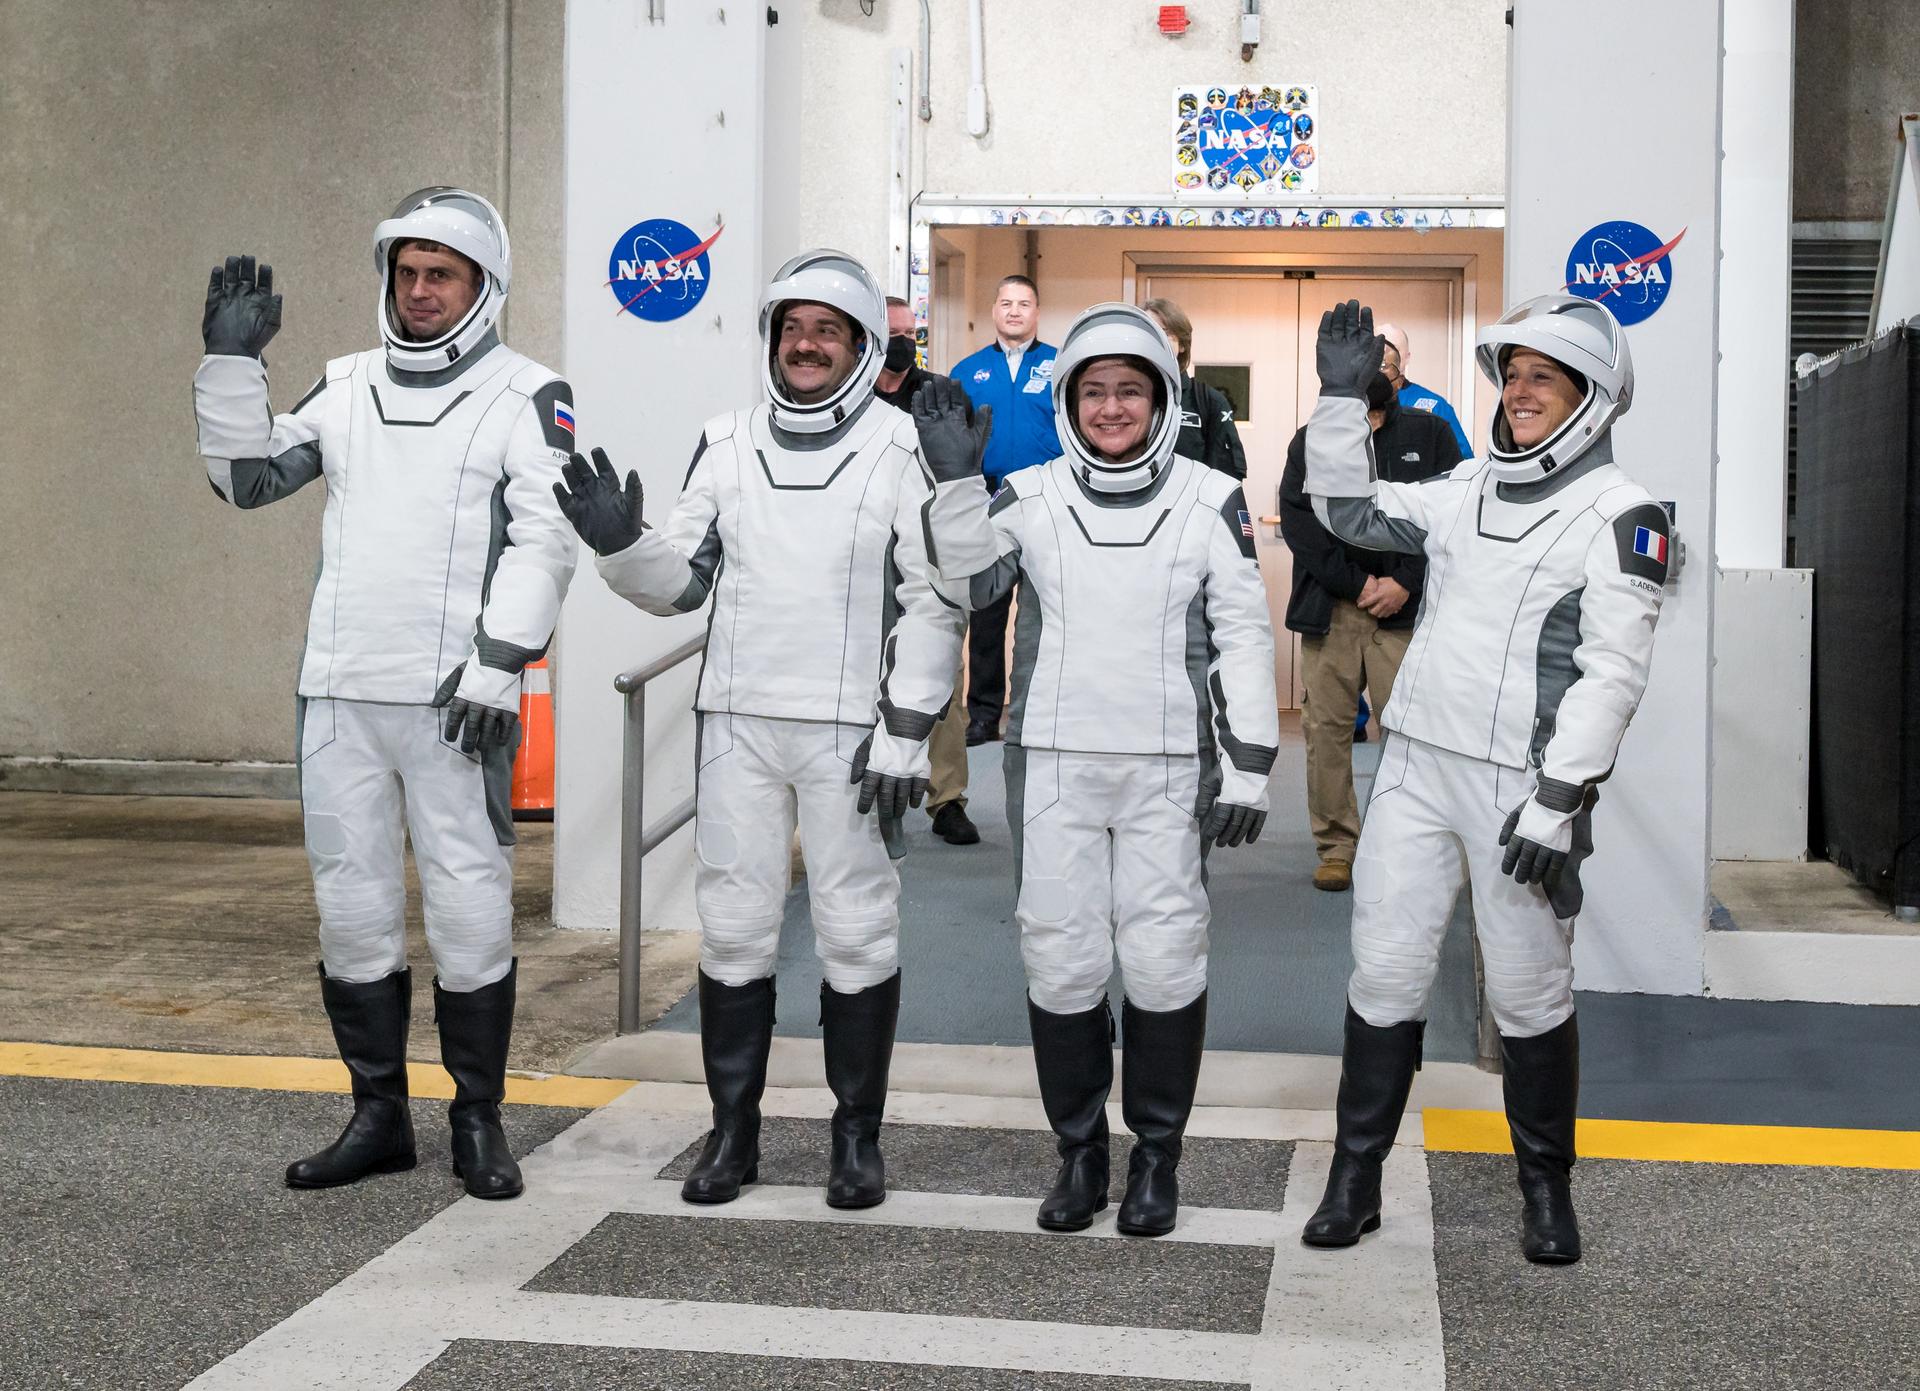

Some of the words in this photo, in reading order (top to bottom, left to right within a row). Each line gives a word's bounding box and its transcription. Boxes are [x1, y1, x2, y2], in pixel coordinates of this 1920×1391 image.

[1206, 129, 1288, 150] NASA
[617, 259, 705, 281] NASA
[1574, 262, 1666, 284] NASA
[1629, 578, 1663, 597] S.ADENOT
